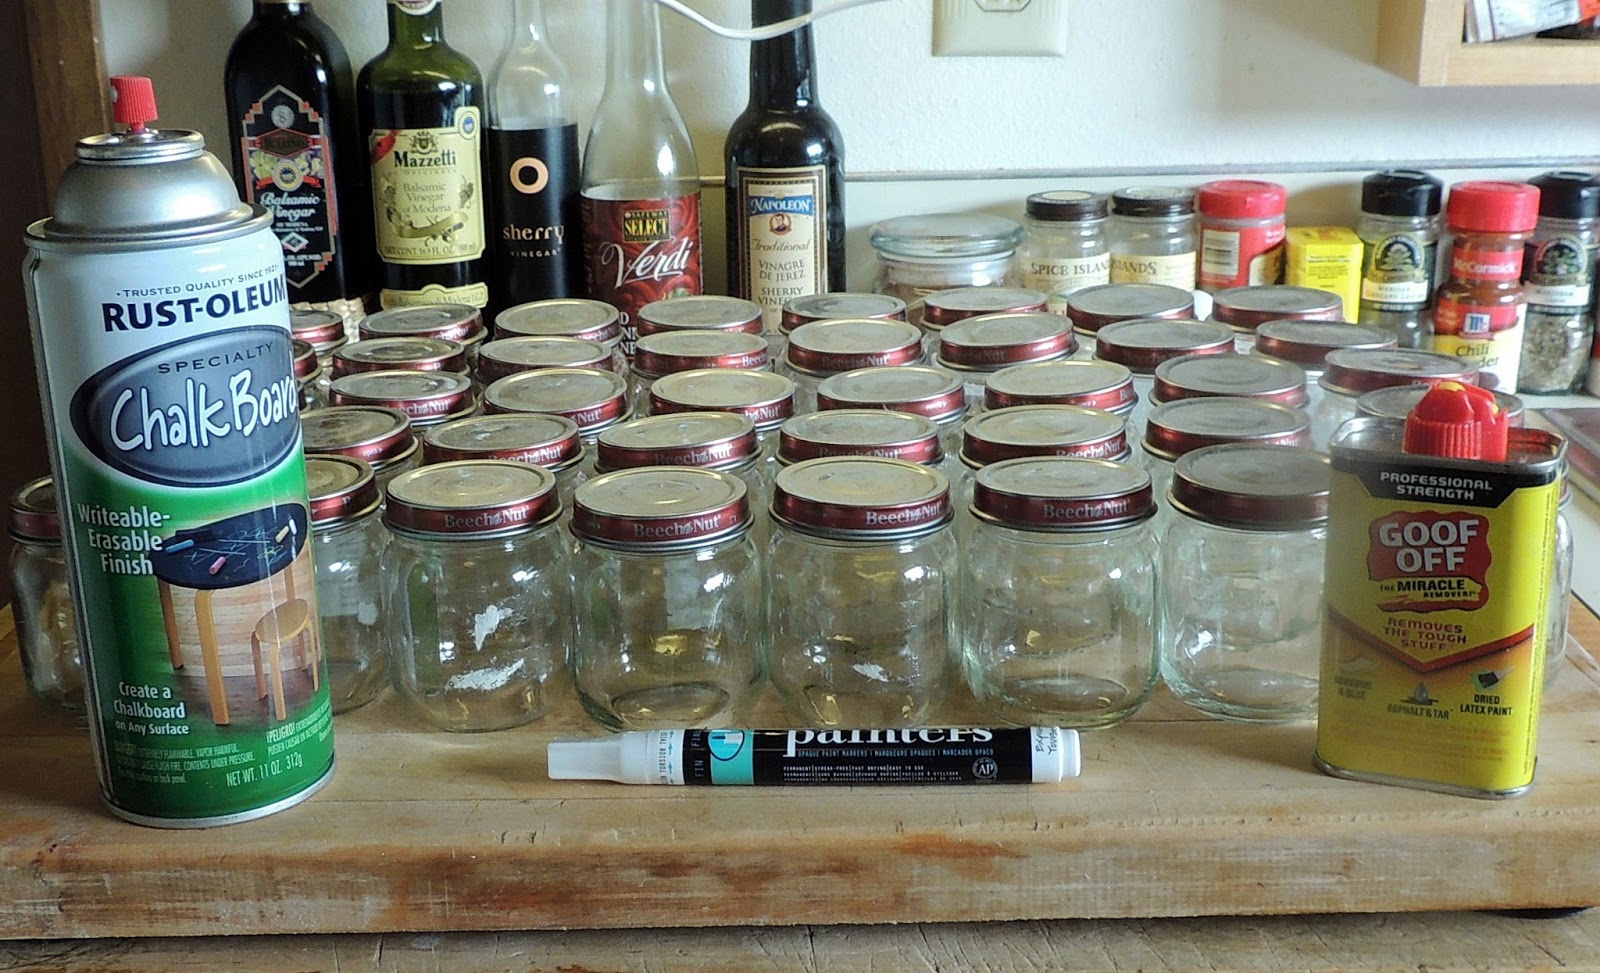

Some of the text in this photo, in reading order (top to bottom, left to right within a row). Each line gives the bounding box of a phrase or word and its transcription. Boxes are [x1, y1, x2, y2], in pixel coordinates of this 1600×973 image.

[394, 150, 457, 168] Mazzetti
[403, 183, 447, 192] Balsamic
[261, 192, 321, 206] Balsamic
[407, 192, 445, 204] Vinegar
[750, 197, 812, 214] NAPOLEON
[413, 203, 452, 213] Modena
[502, 224, 565, 245] sherry
[625, 218, 668, 236] SELECT
[510, 248, 561, 258] VINEGAR
[752, 238, 811, 251] Traditional
[601, 236, 694, 289] Verdi
[759, 259, 805, 271] VINAGRE
[1031, 262, 1069, 276] SPICE
[185, 276, 234, 292] QUALITY
[237, 269, 264, 283] SINCE
[759, 270, 806, 283] DE JEREZ
[761, 286, 804, 296] SHERRY
[101, 275, 286, 333] RUST-OLEUM
[158, 341, 274, 374] SPECIALTY
[1456, 342, 1490, 357] Chili
[1479, 355, 1500, 368] der
[110, 376, 231, 451] Chalk
[1380, 471, 1493, 491] PROFESSIONAL
[1396, 484, 1475, 501] STRENGTH
[88, 528, 164, 551] Erasable
[1379, 519, 1480, 548] GOOF
[101, 552, 154, 575] Finish
[1396, 547, 1467, 573] OFF
[1380, 579, 1466, 593] THE MIRACLE
[1387, 617, 1464, 634] REMOVES
[1383, 627, 1467, 644] THE TOUGH
[1401, 639, 1447, 651] STUFF
[118, 681, 172, 699] Create a
[1473, 694, 1500, 705] DRIED
[113, 699, 186, 720] Chalkboard
[1387, 703, 1424, 716] ASPHALT
[1433, 709, 1450, 720] TAR
[1460, 703, 1513, 715] LATEX PAINT
[115, 721, 190, 736] on Any Surface
[782, 727, 994, 757] painters
[226, 770, 241, 788] NET
[242, 766, 258, 784] WT.
[259, 762, 269, 780] 11
[286, 751, 303, 769] 312g
[978, 763, 994, 775] AP
